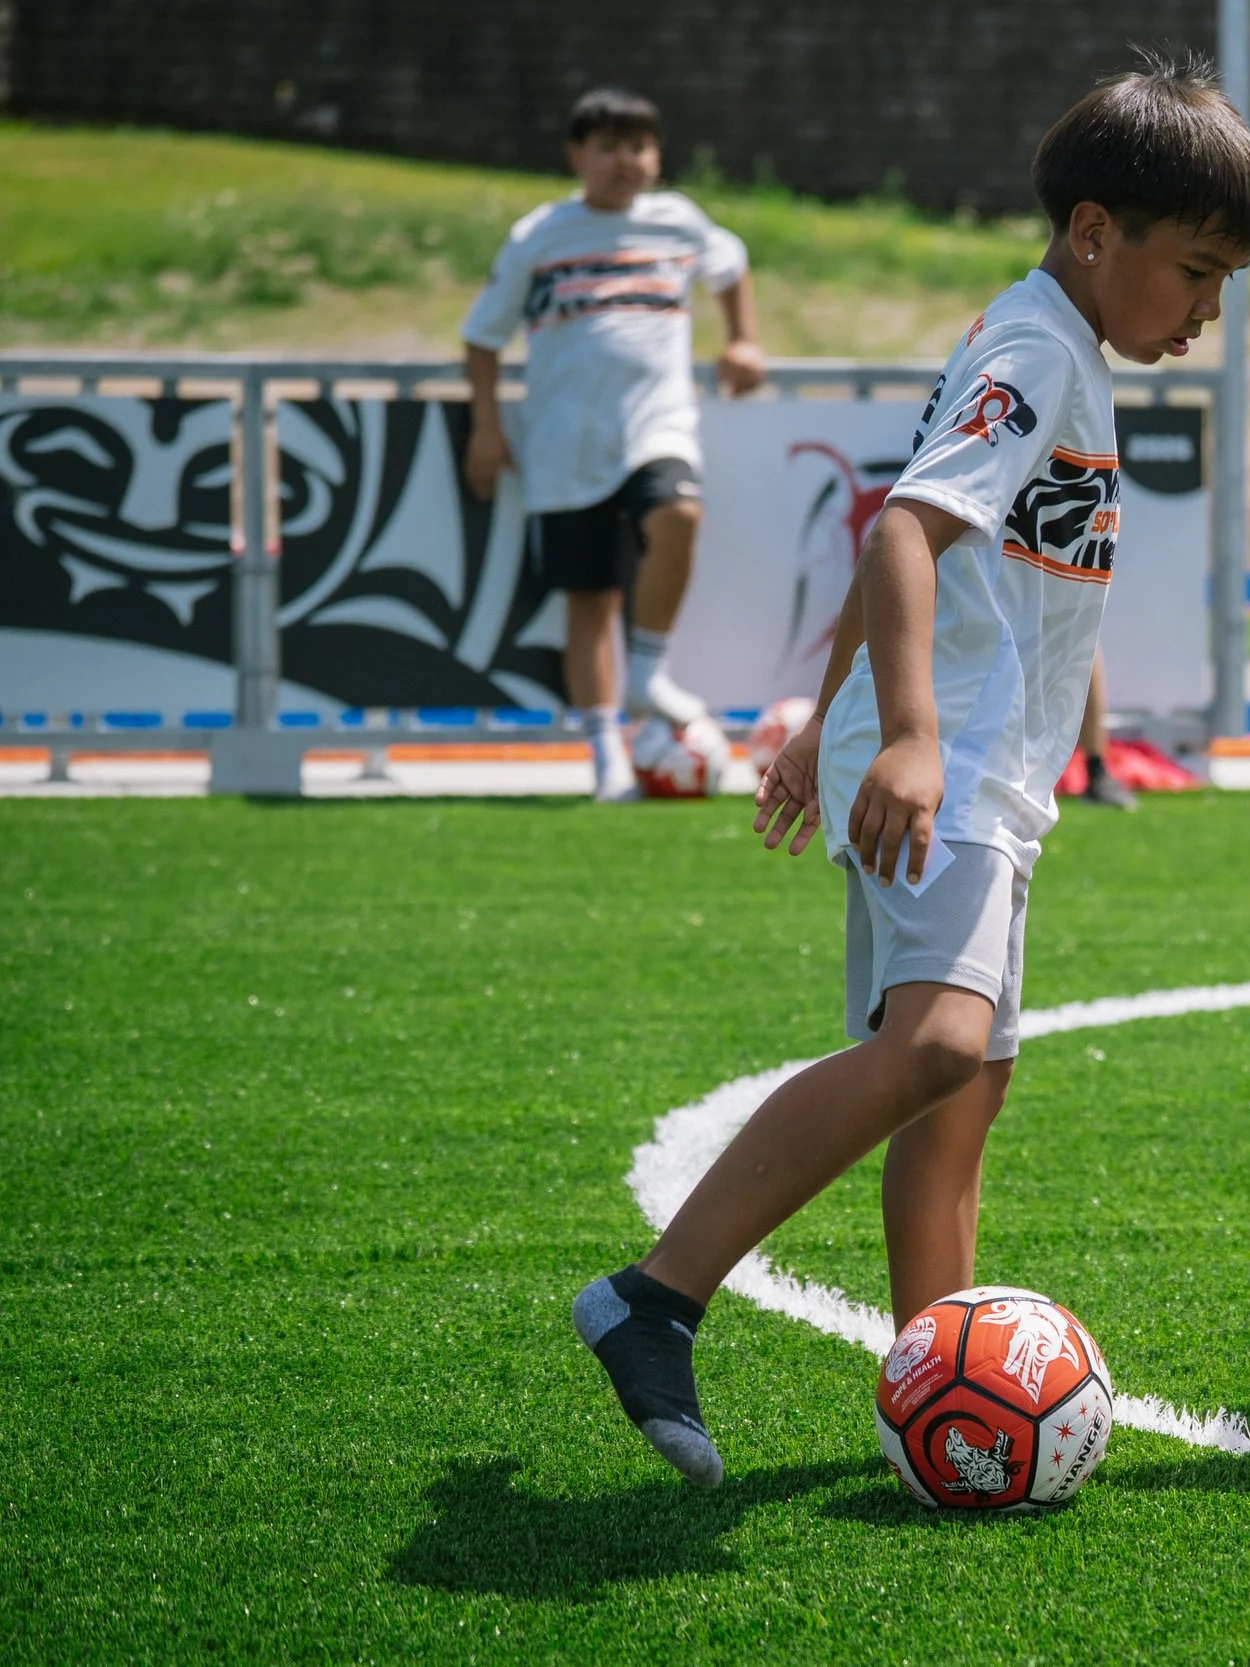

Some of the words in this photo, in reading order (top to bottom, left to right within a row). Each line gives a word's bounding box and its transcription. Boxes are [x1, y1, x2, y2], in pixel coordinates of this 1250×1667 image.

[891, 1382, 907, 1404] HOPE
[906, 1377, 913, 1385] &
[912, 1354, 942, 1379] HEALTH
[1049, 1413, 1103, 1501] CHANGE
